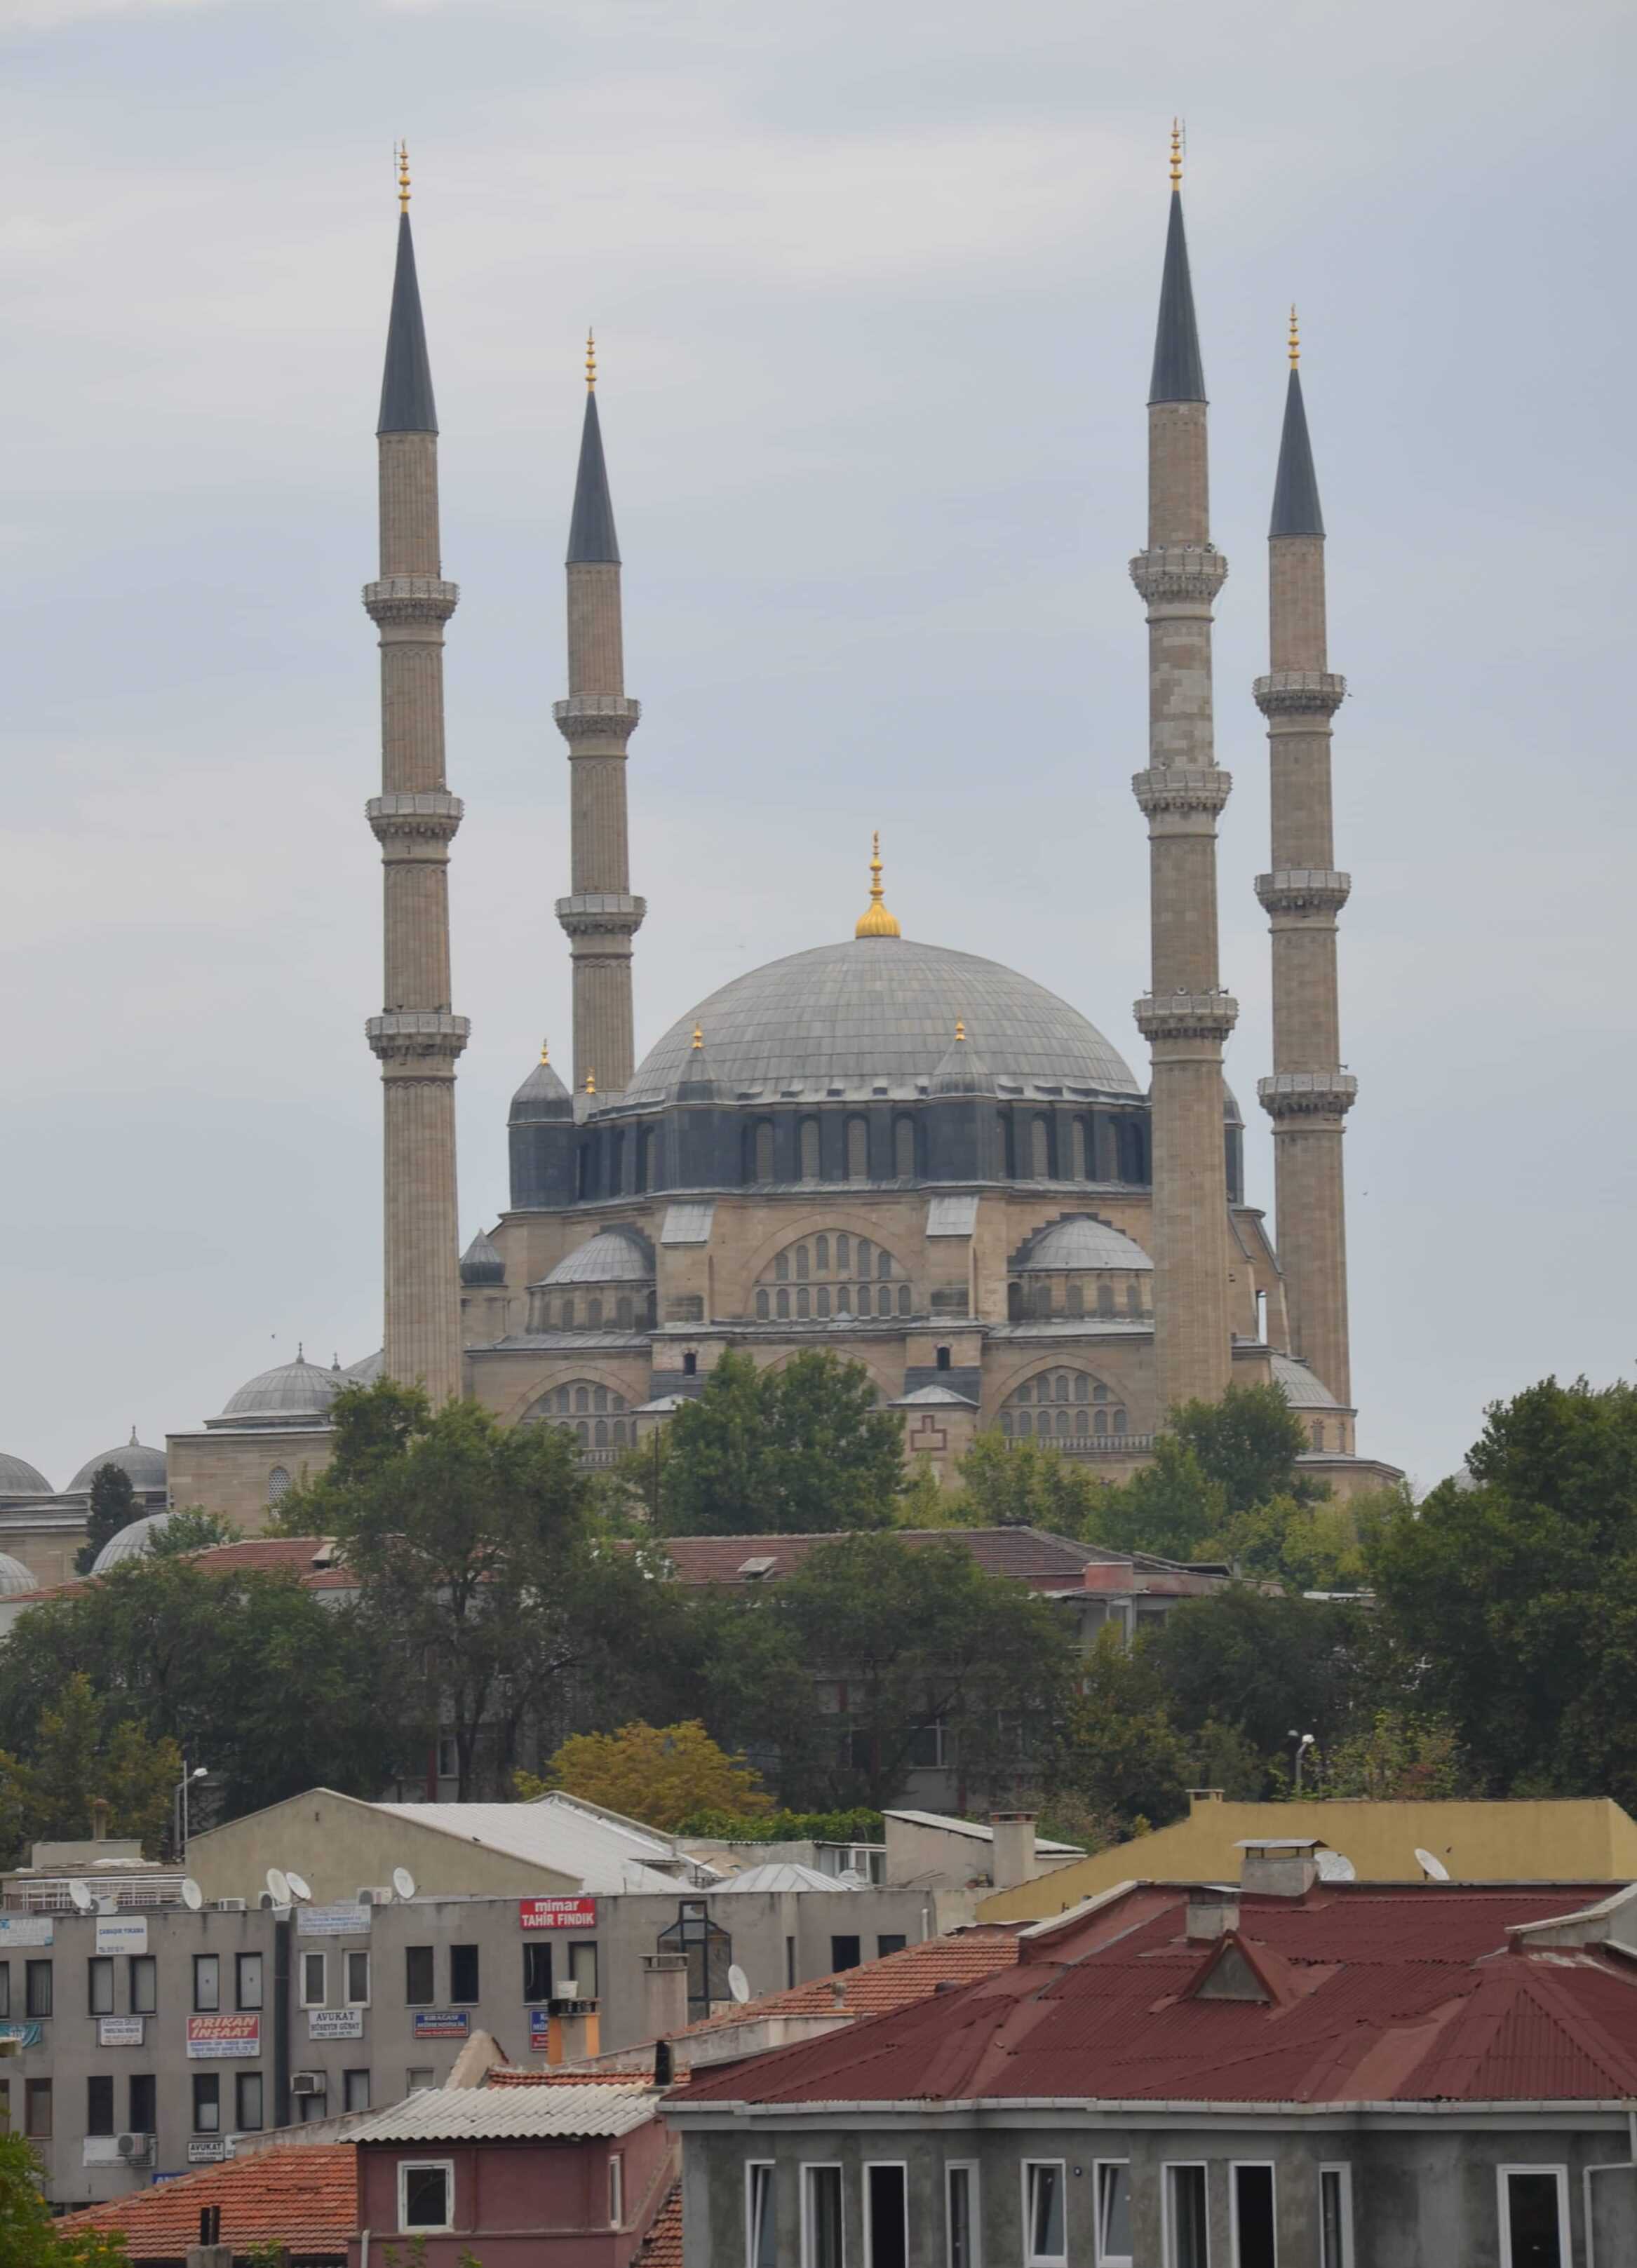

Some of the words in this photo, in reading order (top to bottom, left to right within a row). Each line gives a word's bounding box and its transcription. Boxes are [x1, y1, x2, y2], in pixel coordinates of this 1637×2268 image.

[534, 1899, 581, 1912] mimar
[521, 1912, 555, 1927] TAHİR
[557, 1912, 595, 1926] FINDIK
[191, 2017, 256, 2027] ARIKAN
[316, 2011, 354, 2021] AVUKAT
[191, 2026, 252, 2040] İNŞAAT
